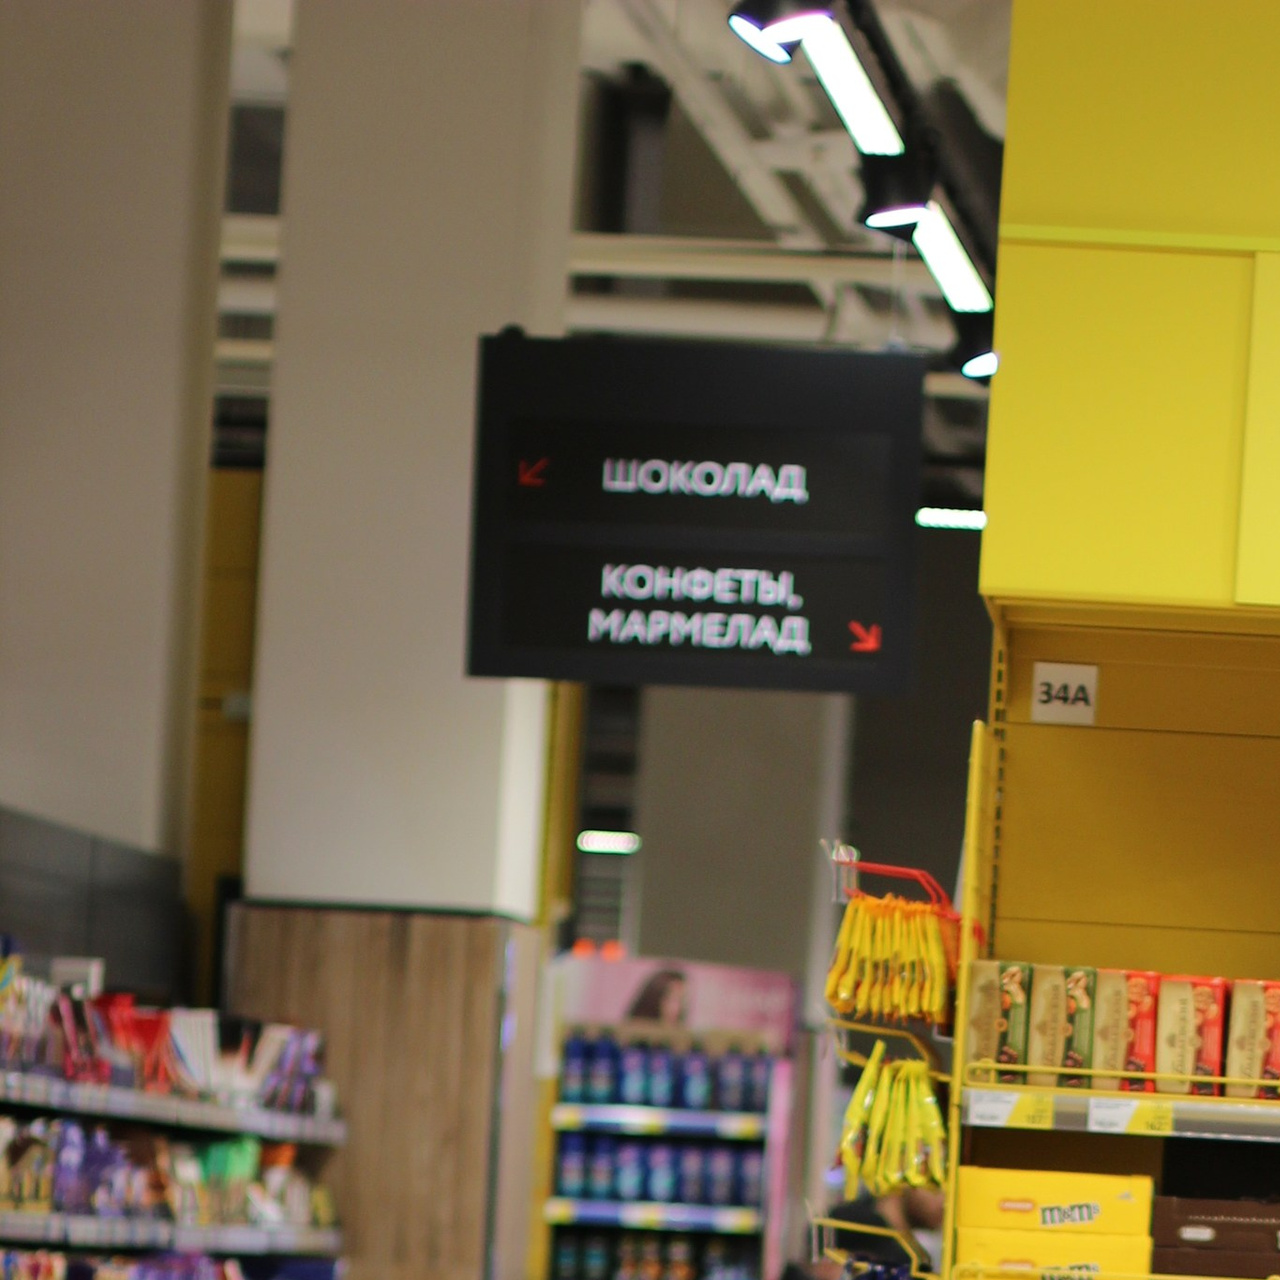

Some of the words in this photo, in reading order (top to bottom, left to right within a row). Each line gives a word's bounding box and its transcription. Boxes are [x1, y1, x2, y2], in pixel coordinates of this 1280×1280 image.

[602, 457, 809, 503] ШОКОЛАД
[601, 564, 804, 610] КОНФЕТЫ,
[588, 608, 812, 656] МАРМЕЛАД
[1037, 681, 1092, 707] 34A
